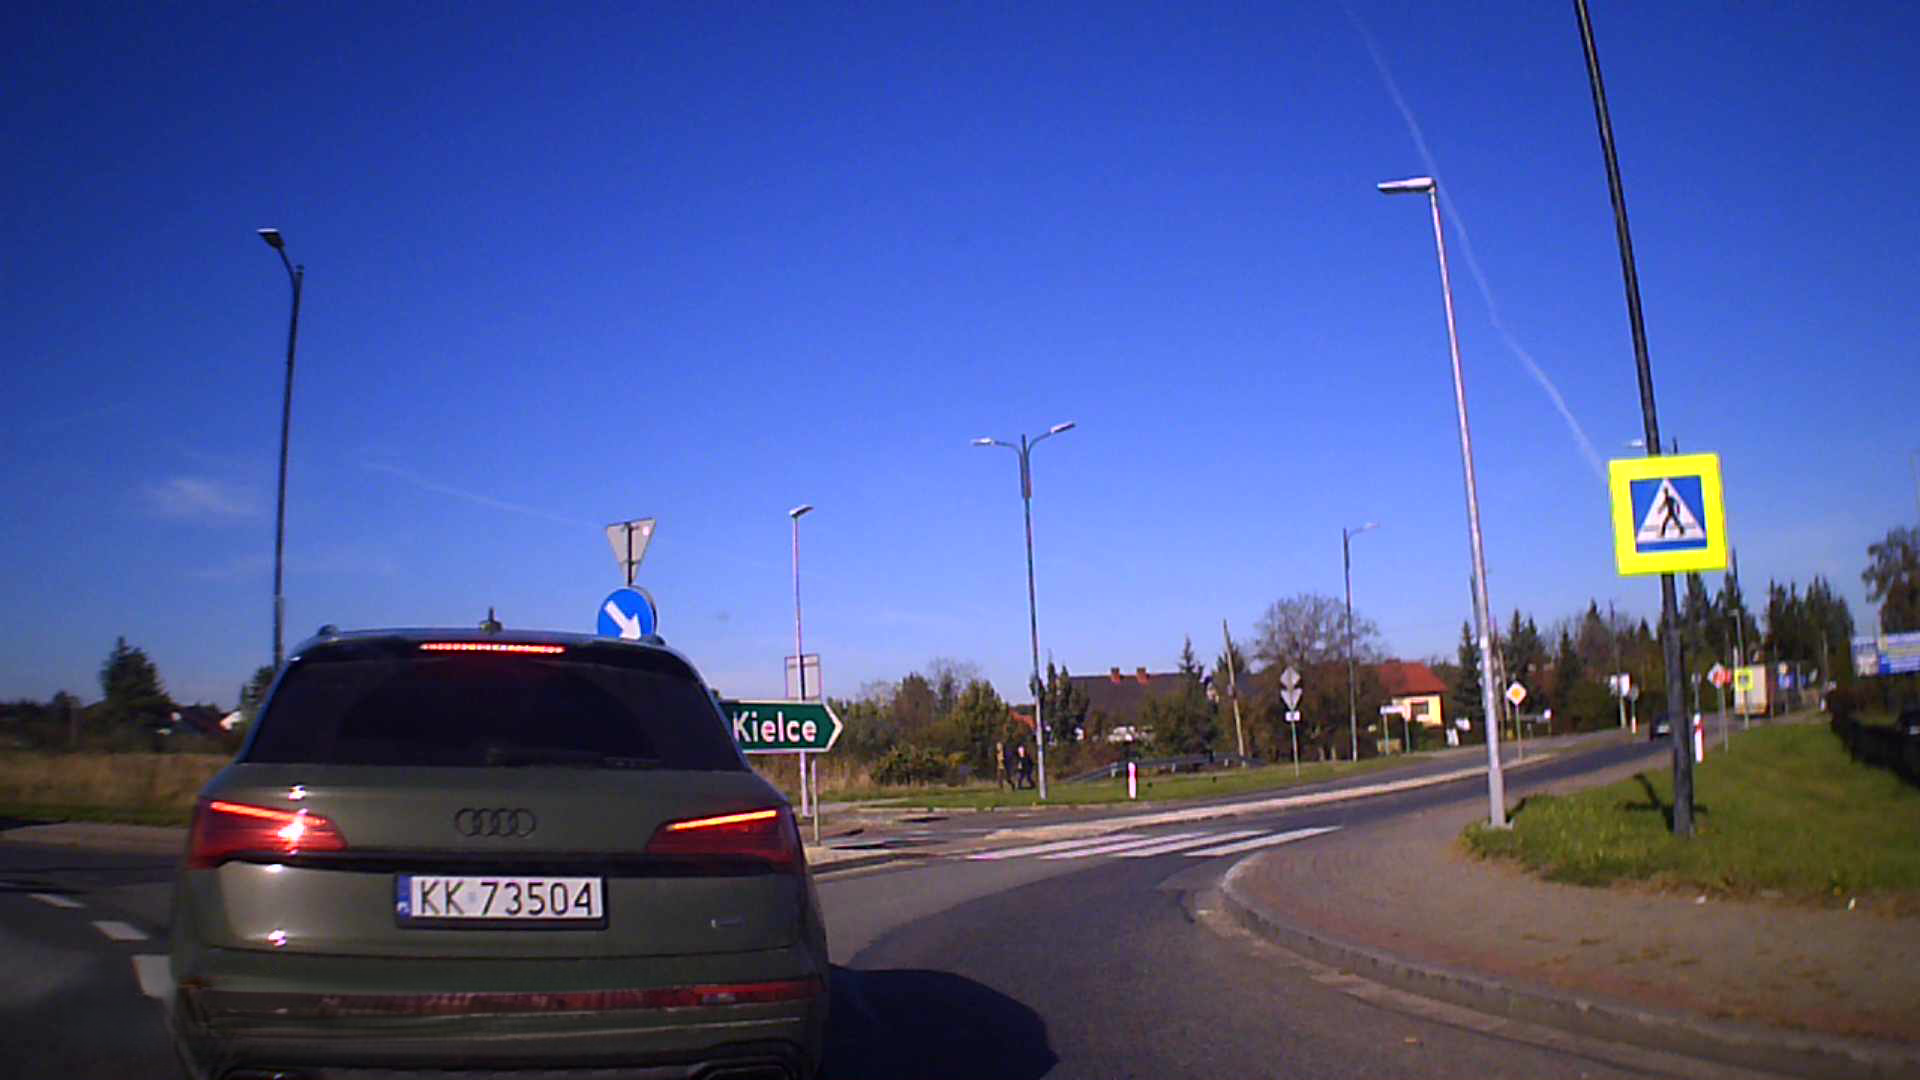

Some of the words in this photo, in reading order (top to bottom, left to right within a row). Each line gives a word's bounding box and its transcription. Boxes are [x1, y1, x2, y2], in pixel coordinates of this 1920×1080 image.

[733, 711, 817, 742] Kielce
[420, 880, 464, 914] KK
[480, 881, 593, 916] 73504
